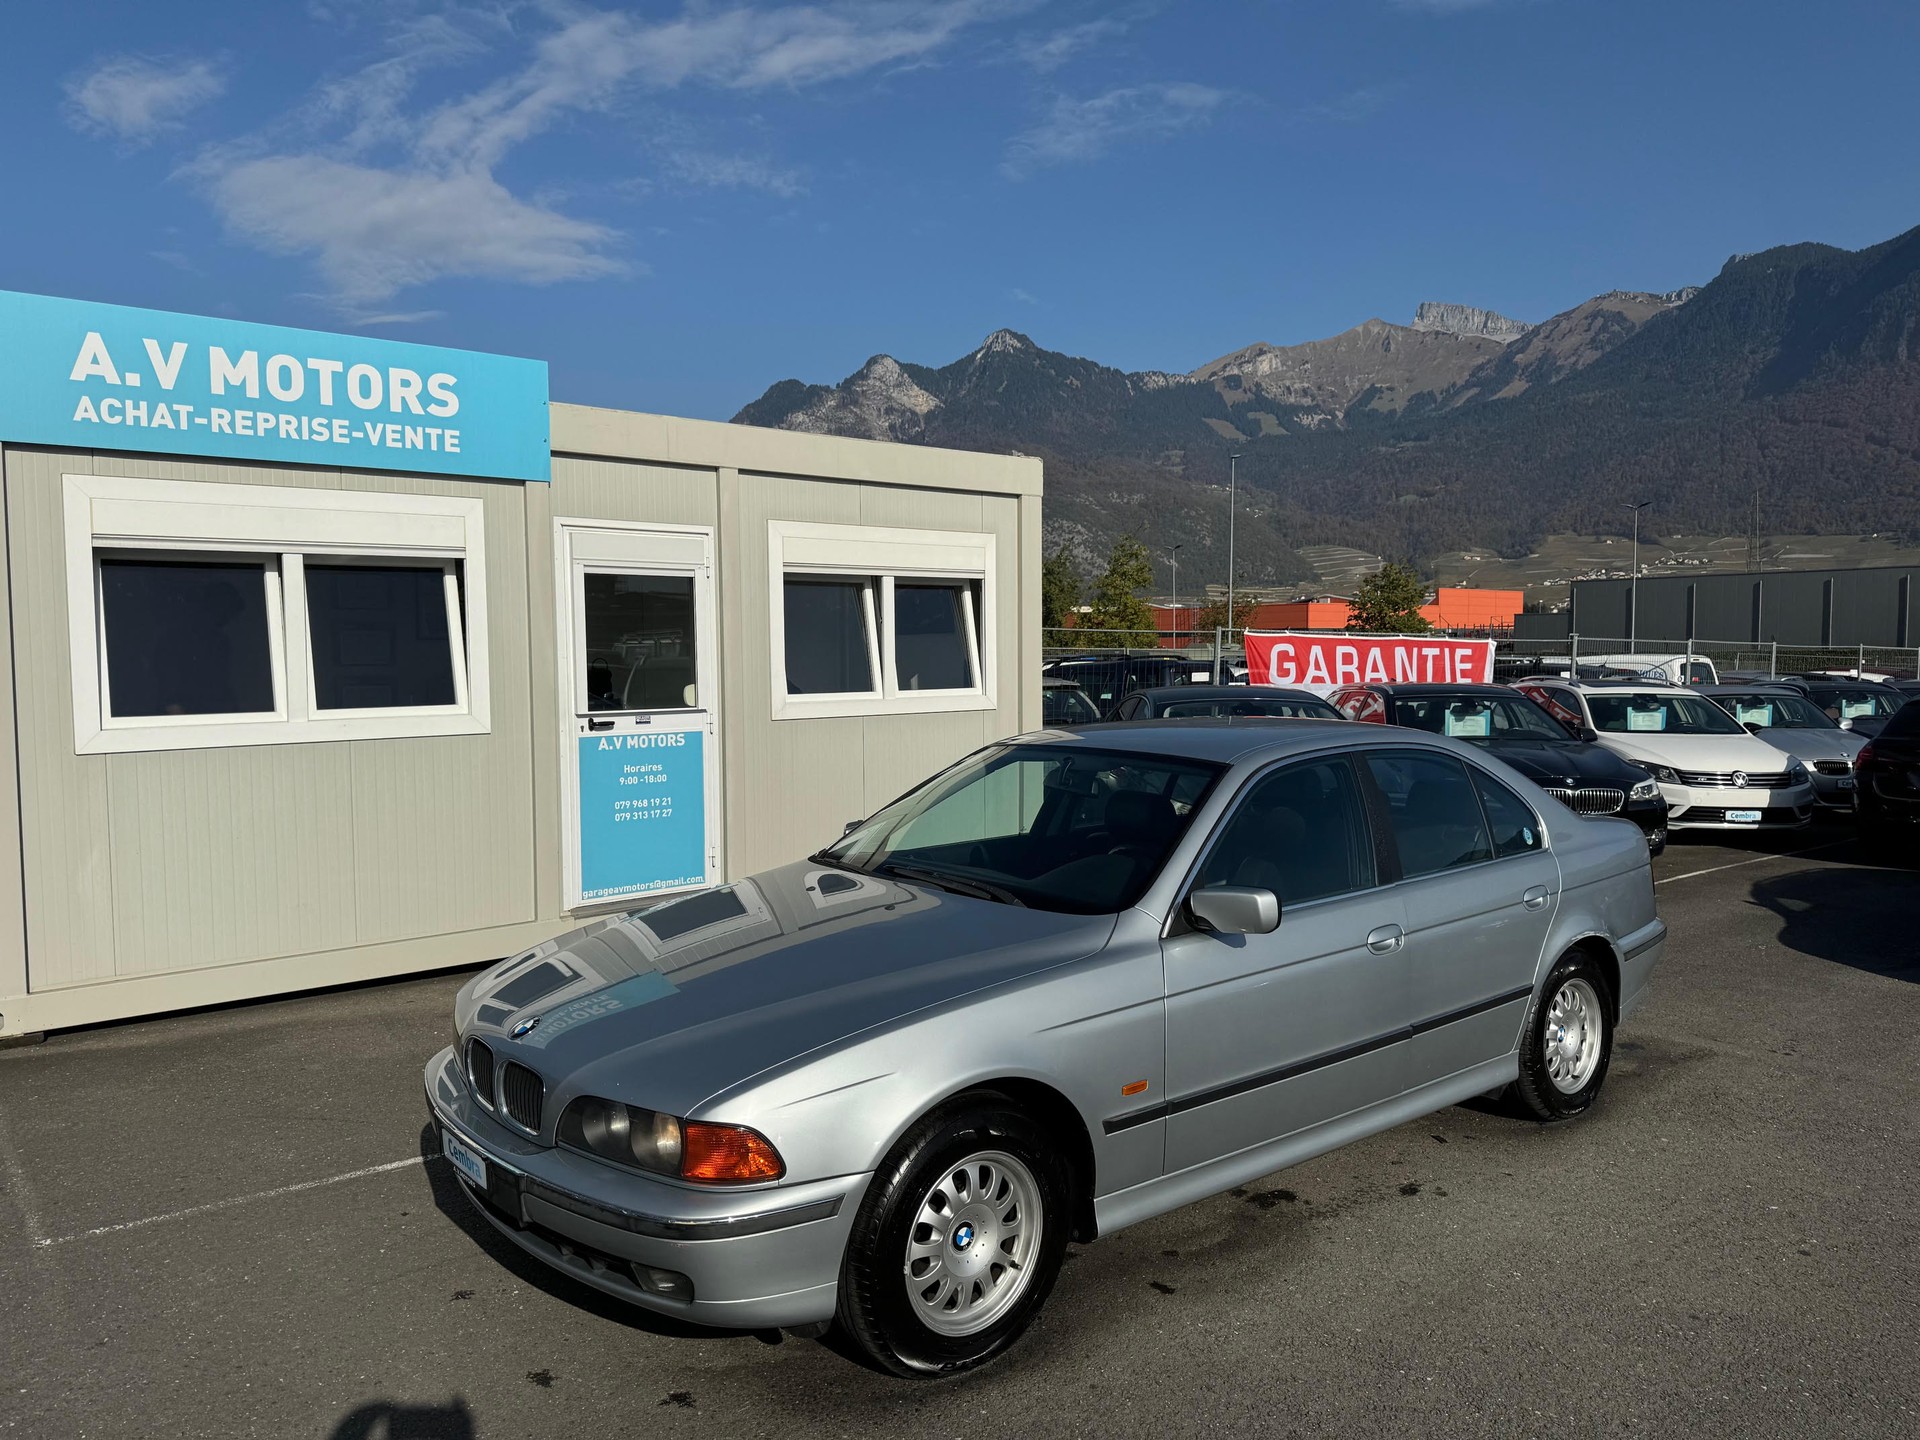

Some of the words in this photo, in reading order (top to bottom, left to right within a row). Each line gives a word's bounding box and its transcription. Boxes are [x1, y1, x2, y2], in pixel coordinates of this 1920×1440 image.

[69, 331, 188, 390] A.V
[209, 346, 460, 417] MOTORS
[73, 395, 461, 453] ACHAT-REPRISE-VENTE
[1269, 643, 1473, 685] GARANTIE
[598, 737, 623, 751] A.V
[626, 733, 685, 749] MOTORS
[623, 764, 663, 773] Horaires
[620, 776, 638, 785] 9:00
[614, 800, 631, 810] 079
[633, 799, 648, 808] 968
[650, 798, 660, 807] 19
[662, 797, 671, 806] 21
[614, 812, 631, 822] 079
[633, 811, 648, 820] 313
[650, 809, 660, 818] 17
[662, 808, 672, 817] 27
[582, 875, 704, 899] garageavmotors@gmail.com
[448, 1137, 483, 1180] Cembra
